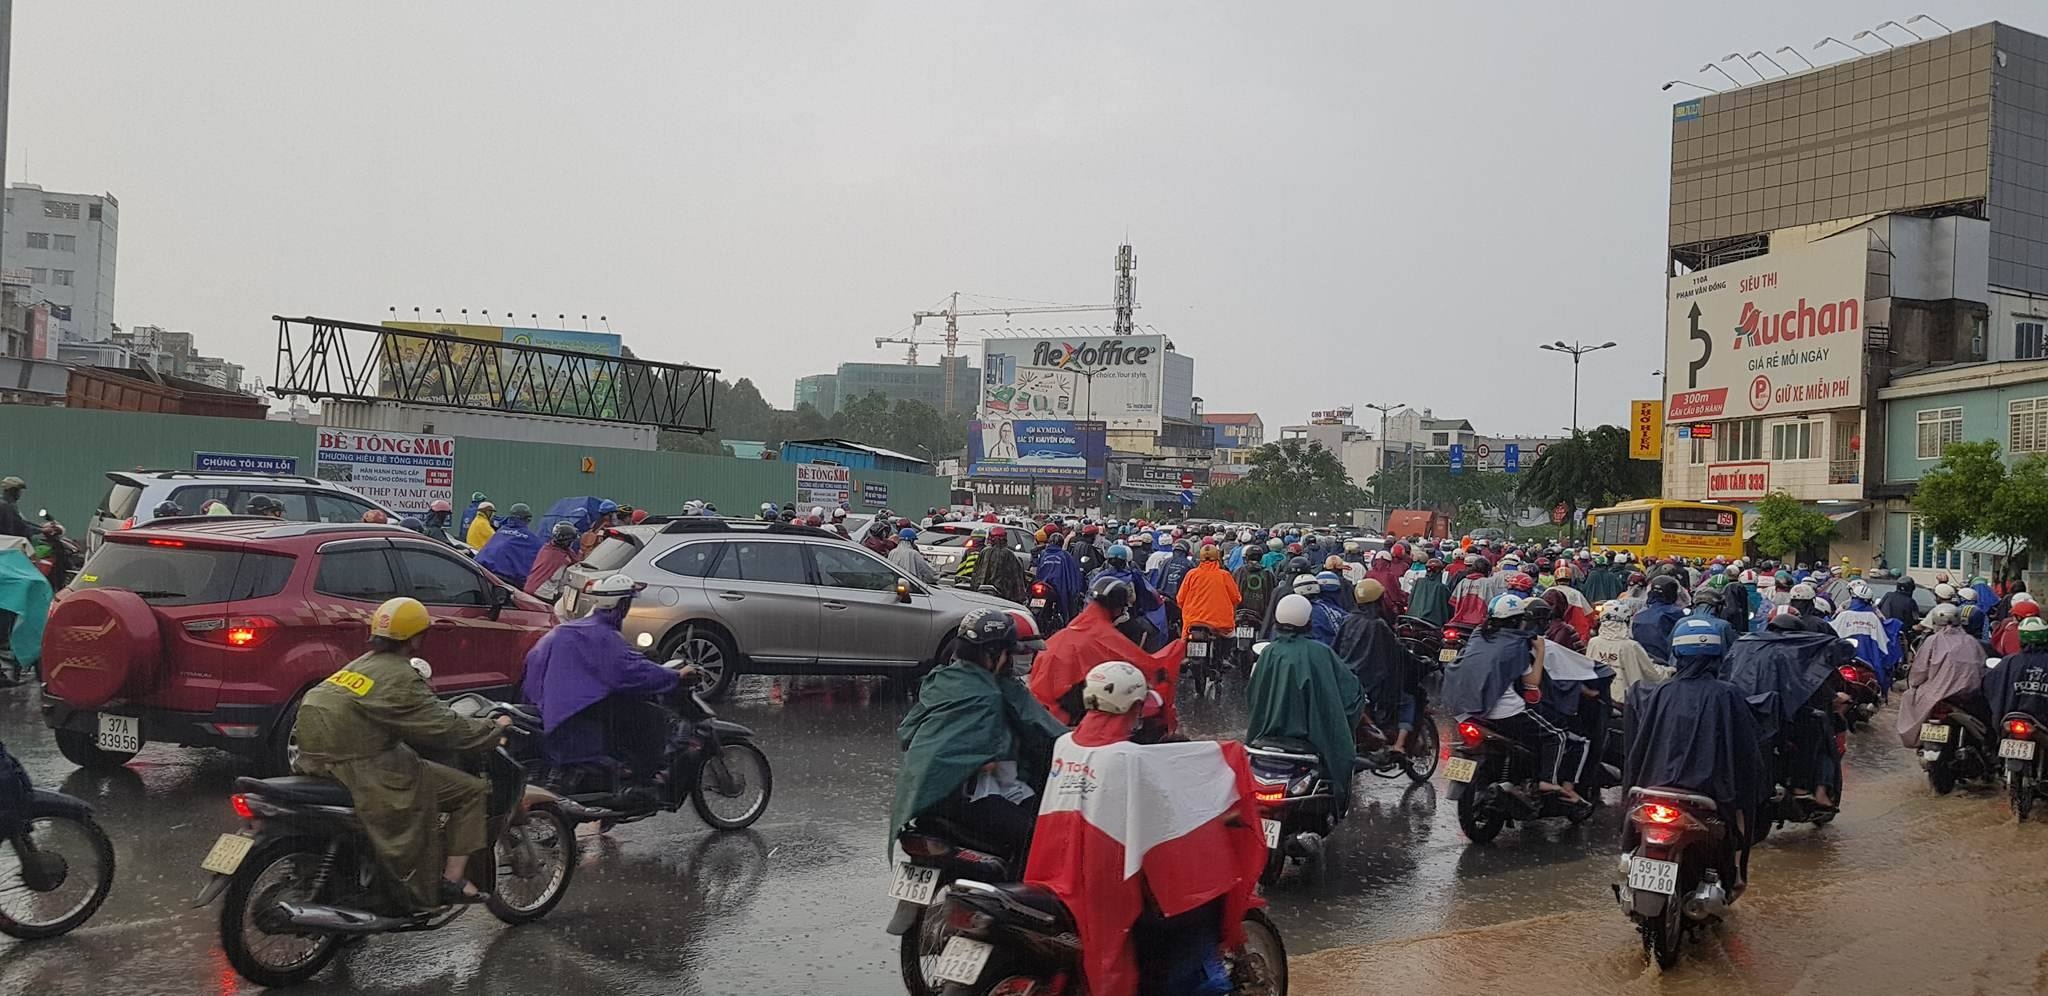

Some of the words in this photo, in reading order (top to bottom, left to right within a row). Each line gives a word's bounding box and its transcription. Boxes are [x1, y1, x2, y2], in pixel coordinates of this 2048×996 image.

[1692, 275, 1708, 286] 110A
[1740, 275, 1760, 294] SIÊU
[1762, 271, 1778, 289] THỊ
[1733, 297, 1859, 350] Auchan
[1748, 356, 1764, 371] GIÁ
[1766, 350, 1779, 369] RẺ
[1800, 346, 1830, 364] NGÀY
[1683, 393, 1709, 405] 300m
[1775, 383, 1793, 404] GIỮ
[1793, 384, 1804, 402] XE
[1805, 377, 1830, 401] MIỄN
[1832, 375, 1850, 398] PHÍ
[319, 431, 348, 450] BÊ
[353, 434, 410, 454] TÔNG
[202, 457, 237, 467] CHÚNG
[238, 458, 255, 468] TÔI
[256, 460, 273, 469] XIN
[275, 459, 290, 470] LỖI
[389, 455, 411, 465] TÔNG
[1002, 480, 1031, 496] KÍNH
[1710, 472, 1728, 491] CƠM
[1729, 468, 1747, 490] TẤM
[1748, 473, 1765, 490] 333
[429, 489, 452, 499] GIAO
[1718, 513, 1733, 525] 159
[108, 718, 129, 735] 37A
[100, 732, 138, 751] 339.56
[901, 865, 934, 884] 70-K9
[1639, 860, 1671, 878] 59-V2
[895, 881, 929, 900] 2168
[1633, 872, 1673, 892] 117.80
